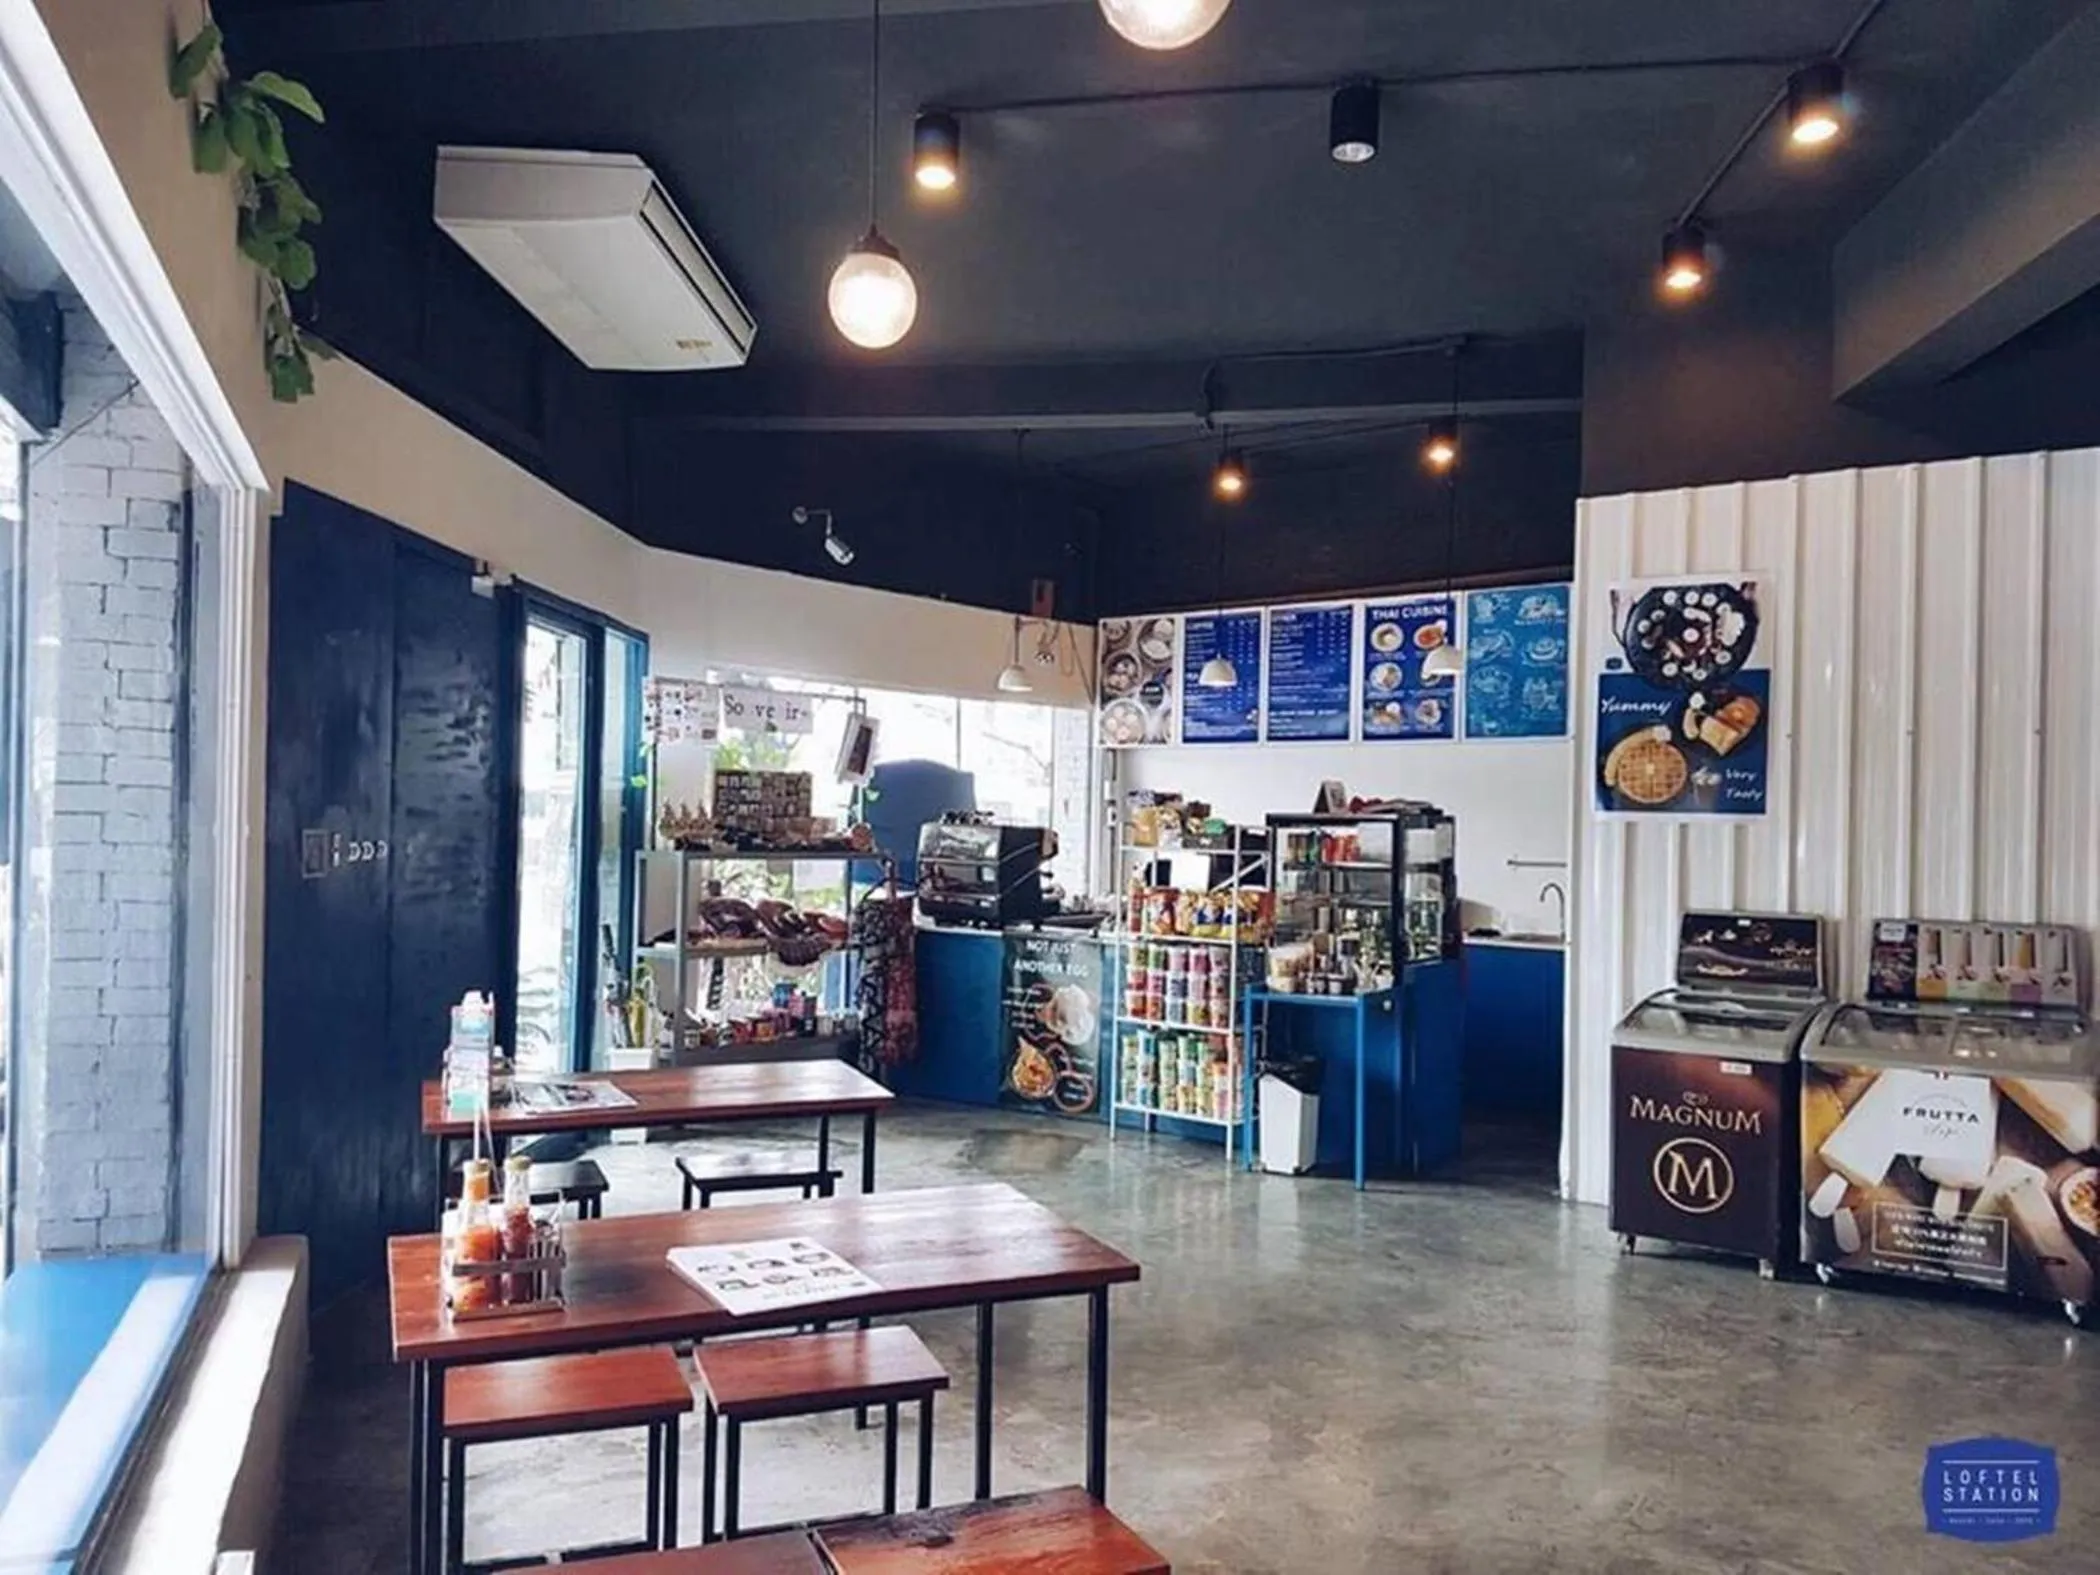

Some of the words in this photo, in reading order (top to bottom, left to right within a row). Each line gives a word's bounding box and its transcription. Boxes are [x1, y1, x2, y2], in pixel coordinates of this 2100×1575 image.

[1372, 607, 1400, 620] THAI
[1401, 603, 1448, 618] CUISINE
[1026, 940, 1049, 953] NOT
[1051, 942, 1077, 954] JUST
[1014, 958, 1063, 974] ANOTHER
[1066, 962, 1089, 978] EGG
[1630, 1094, 1762, 1134] MAGNUM
[1903, 1106, 1979, 1123] FRUTTA
[1668, 1149, 1719, 1200] M
